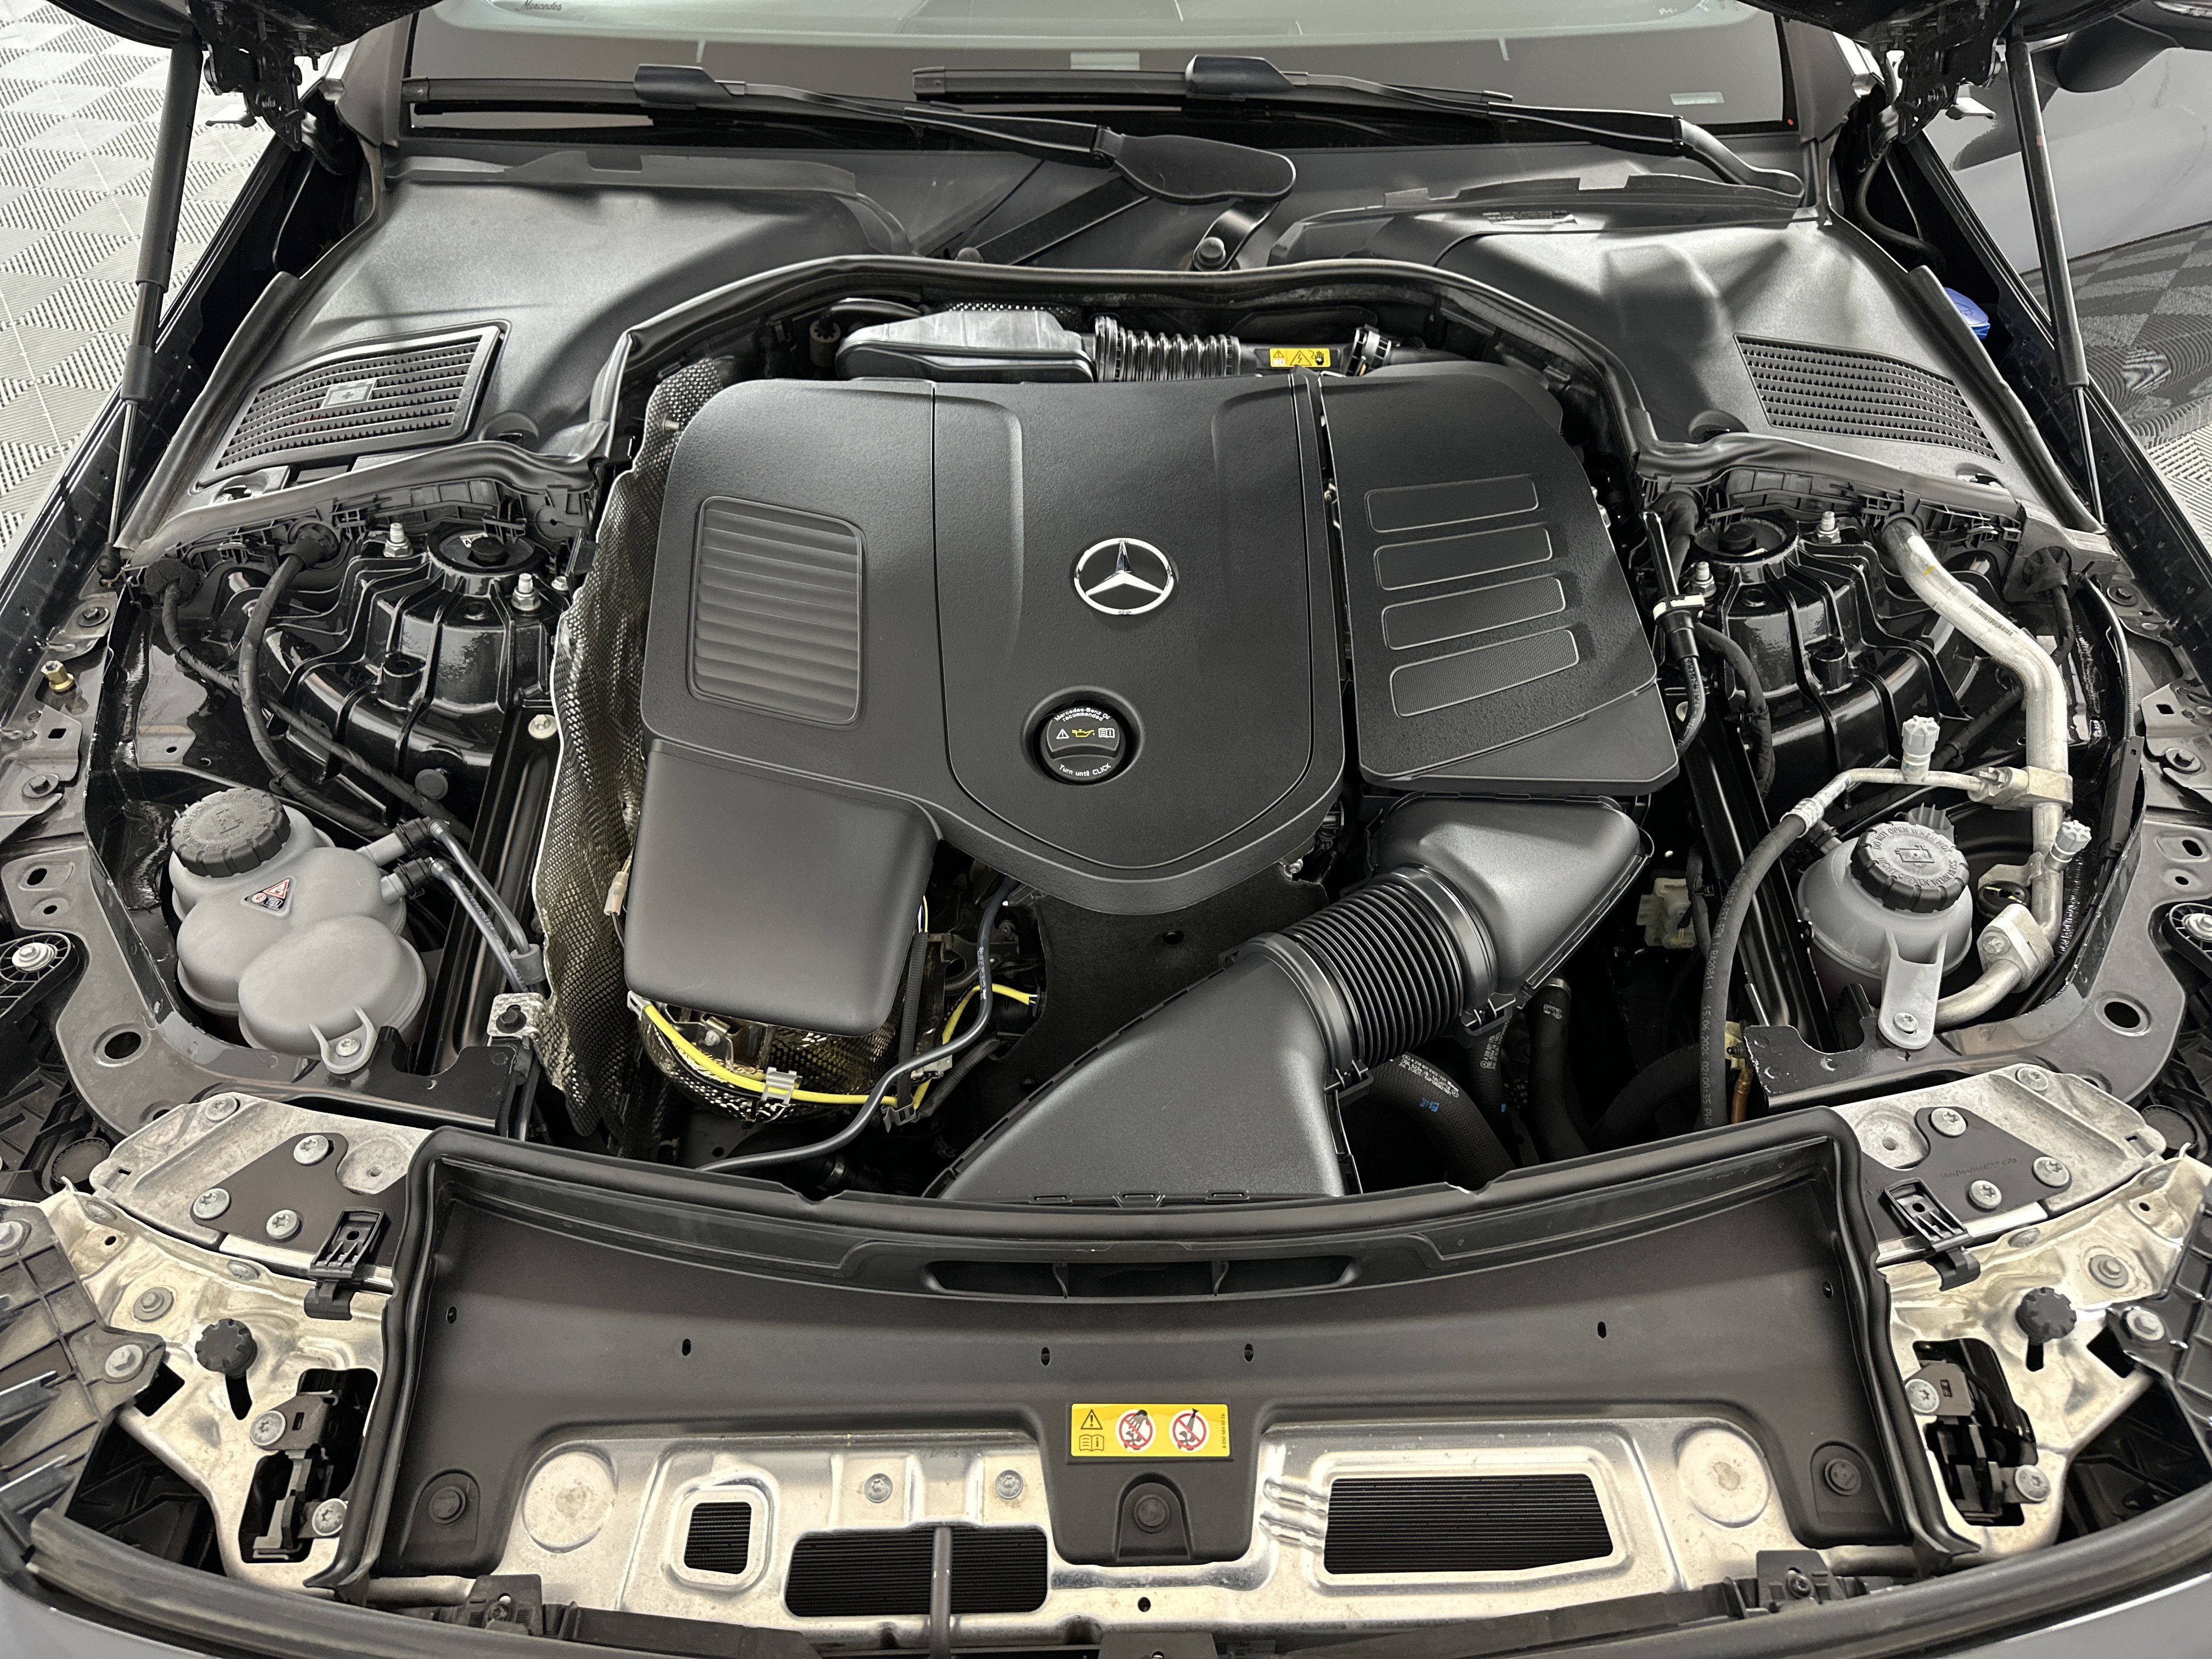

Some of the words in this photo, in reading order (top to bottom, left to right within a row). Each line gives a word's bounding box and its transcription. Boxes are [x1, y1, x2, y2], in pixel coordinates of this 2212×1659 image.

[1054, 707, 1102, 721] Mercedes-Benz
[1102, 712, 1111, 720] Oil
[1062, 712, 1104, 722] recommended
[1059, 764, 1073, 775] Turn
[1092, 763, 1112, 775] CLICK
[252, 796, 266, 810] OPEN
[1888, 826, 1910, 834] OPEN
[1875, 831, 1889, 843] NOT
[206, 843, 231, 851] HEISS
[1872, 839, 1882, 850] DO
[1936, 839, 1953, 853] HOT
[1877, 856, 1899, 874] NICHT
